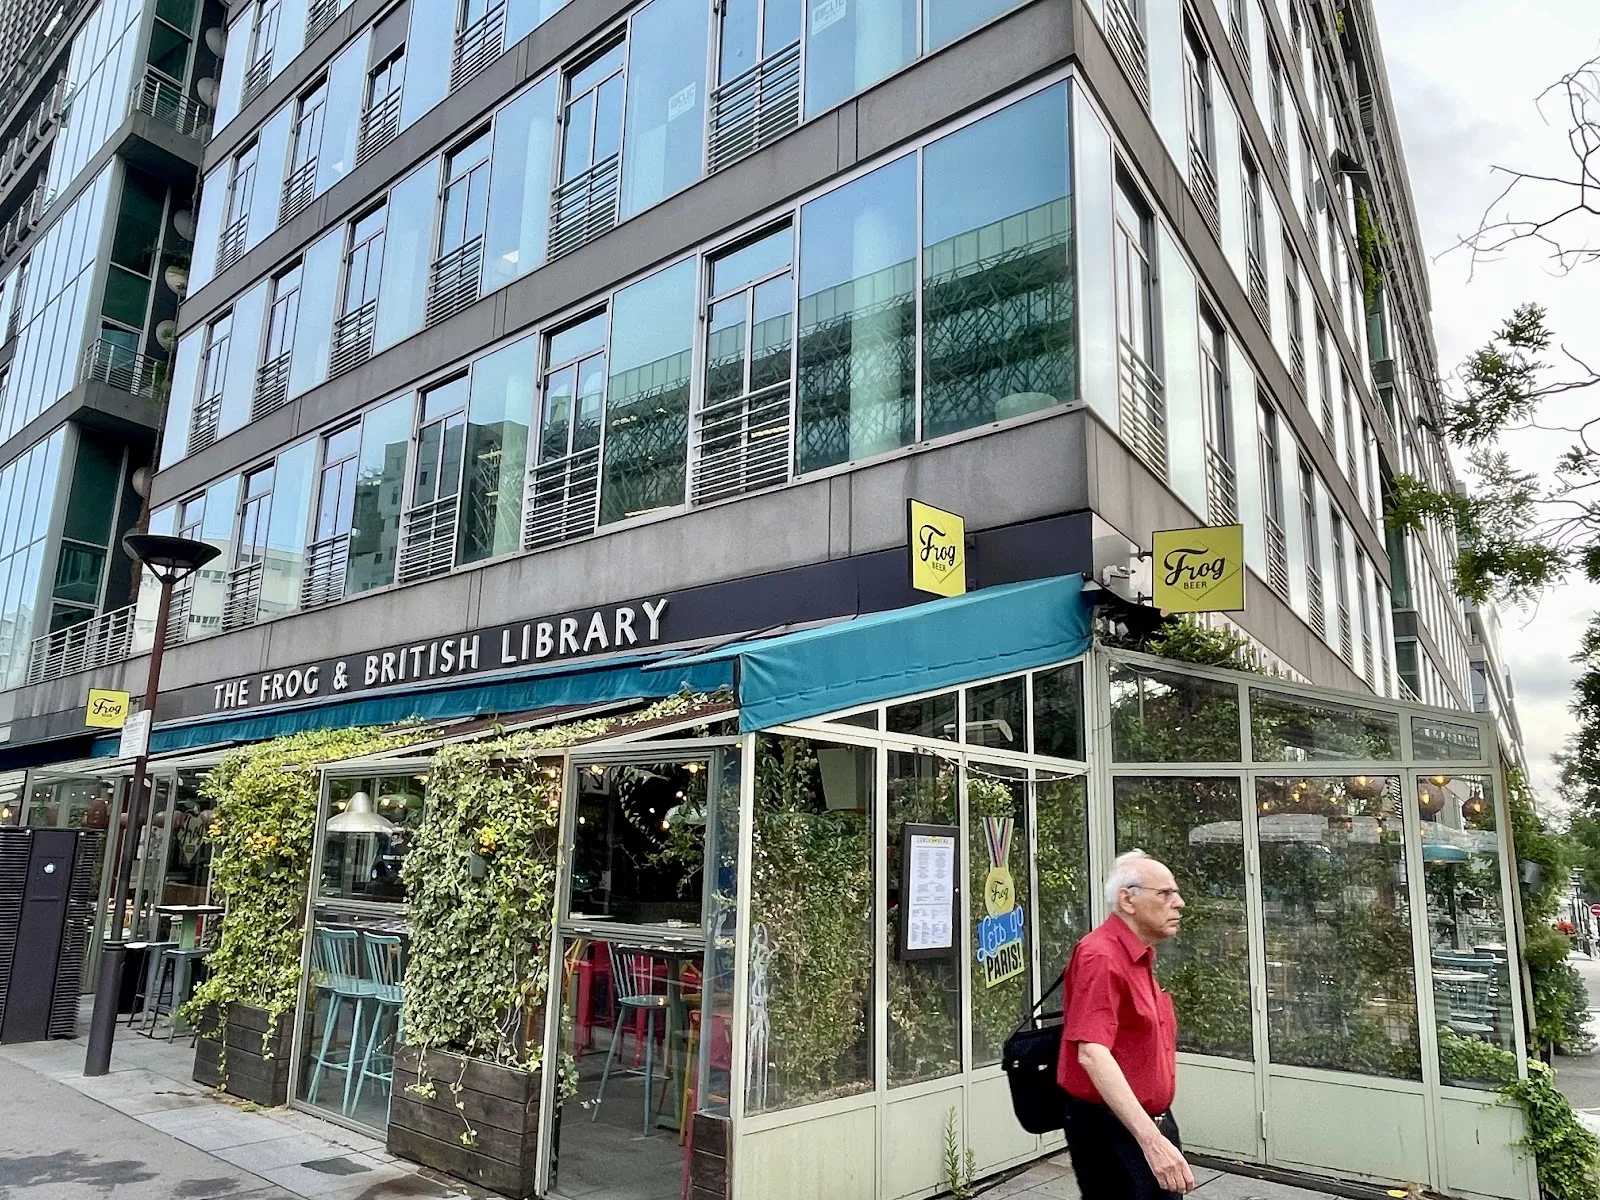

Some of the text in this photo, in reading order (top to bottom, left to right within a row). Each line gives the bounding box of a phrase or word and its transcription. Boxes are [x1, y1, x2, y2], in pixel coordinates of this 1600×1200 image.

[919, 524, 956, 567] Frog
[932, 561, 947, 572] BEER
[1163, 547, 1226, 587] Frog
[1183, 581, 1208, 590] BEER
[213, 598, 668, 709] THE FROG & BRITISH LIBRARY
[92, 697, 122, 715] Frog
[1010, 905, 1024, 941] go
[986, 942, 1022, 982] PARIS!
